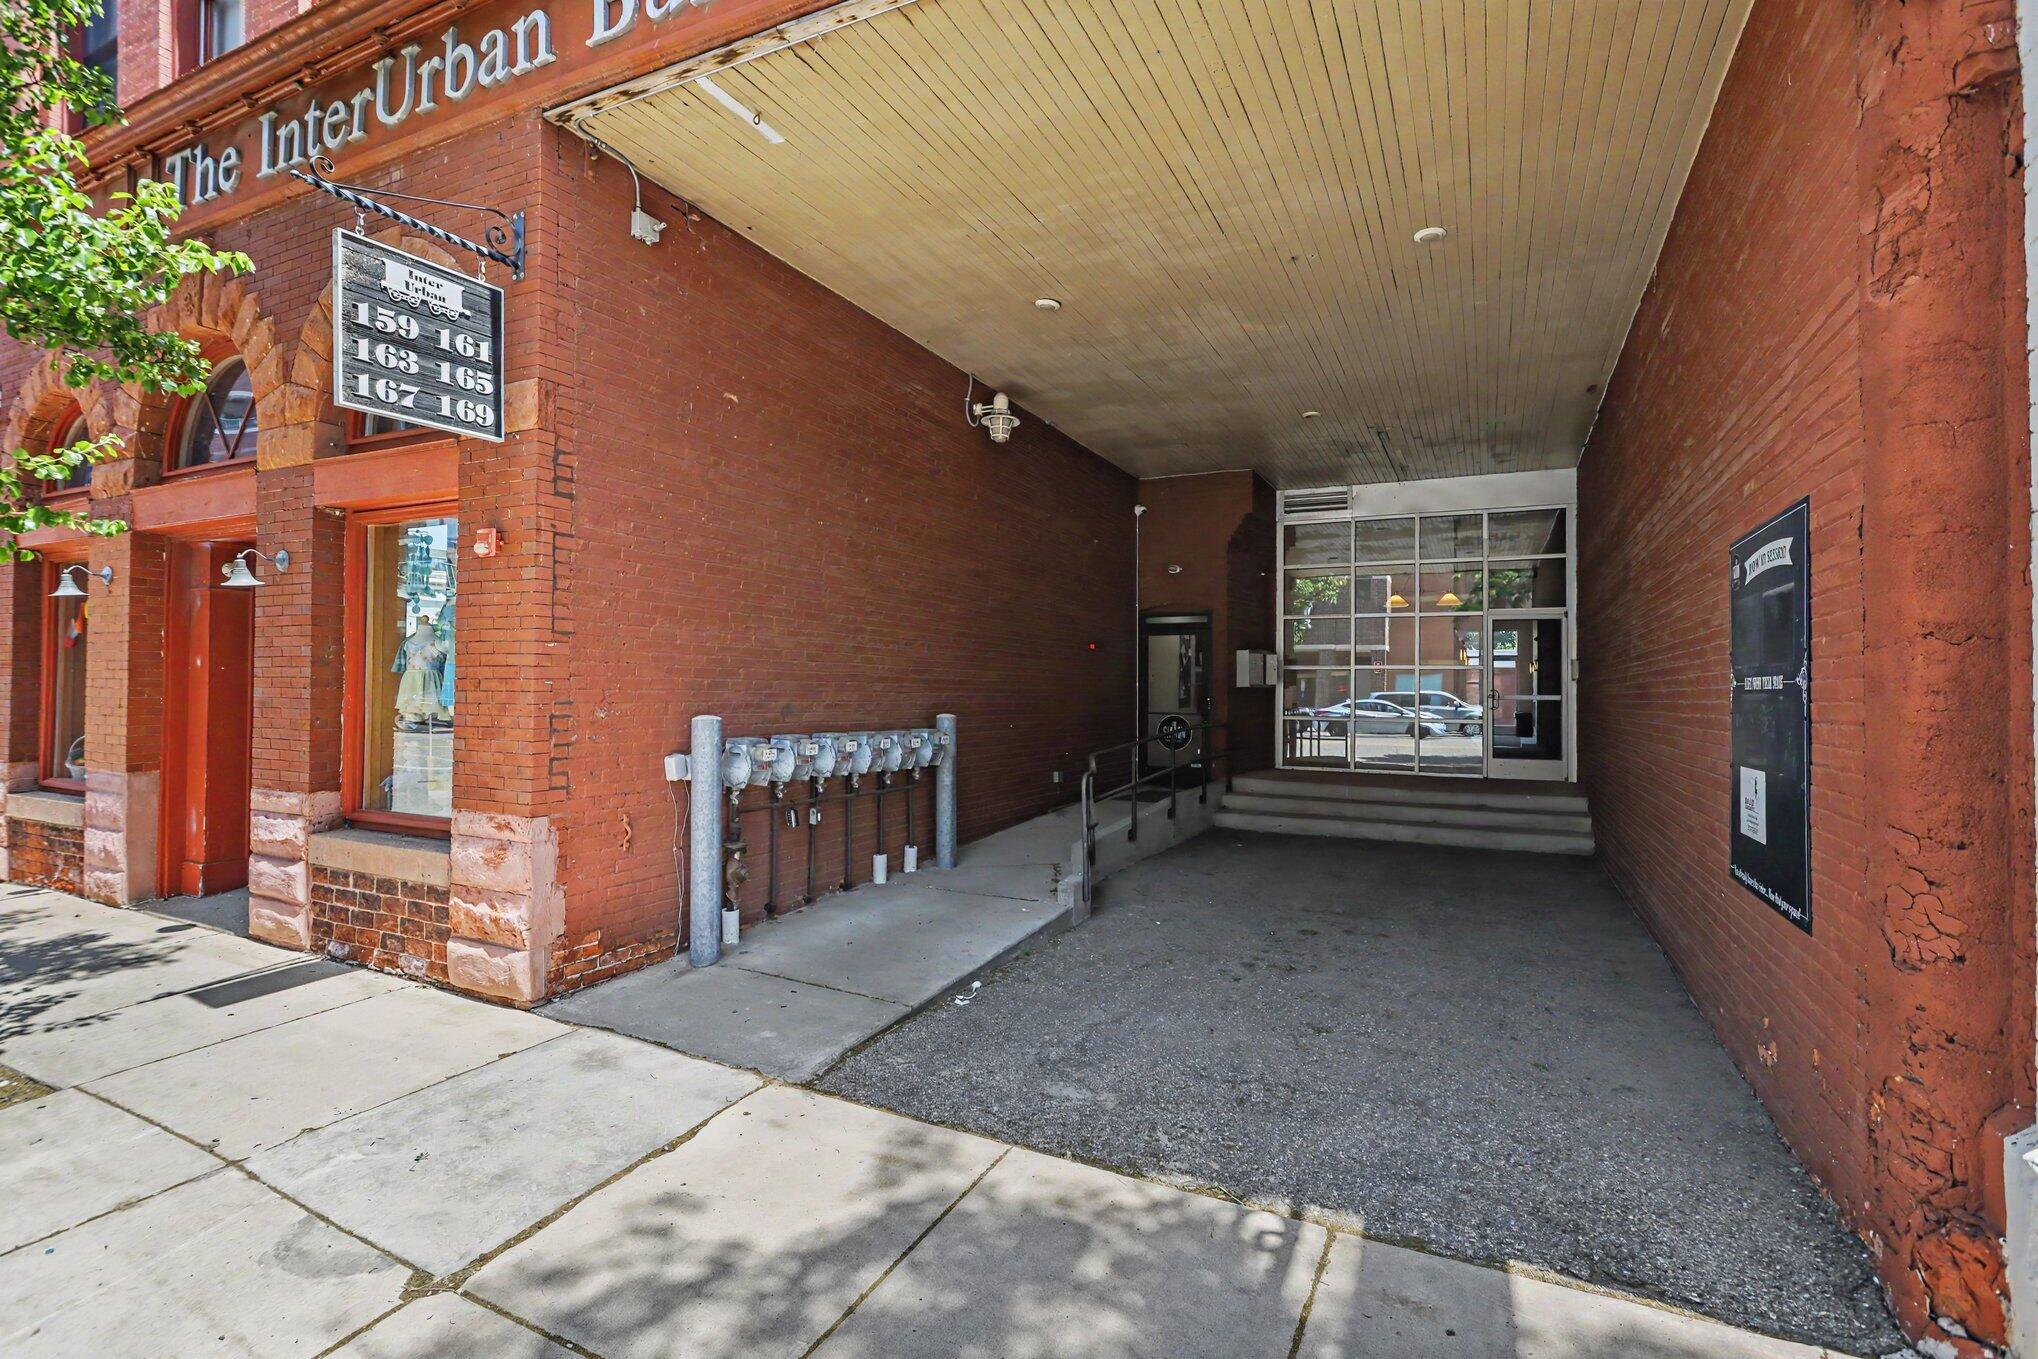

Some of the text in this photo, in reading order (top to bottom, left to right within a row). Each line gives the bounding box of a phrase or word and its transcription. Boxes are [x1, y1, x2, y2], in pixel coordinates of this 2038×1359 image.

[165, 143, 241, 210] The
[256, 8, 557, 179] InterUrban
[404, 280, 447, 304] Urban
[408, 269, 444, 290] Inter
[351, 301, 493, 365] 159 161
[351, 338, 494, 396] 163 165
[351, 373, 495, 428] 167 169
